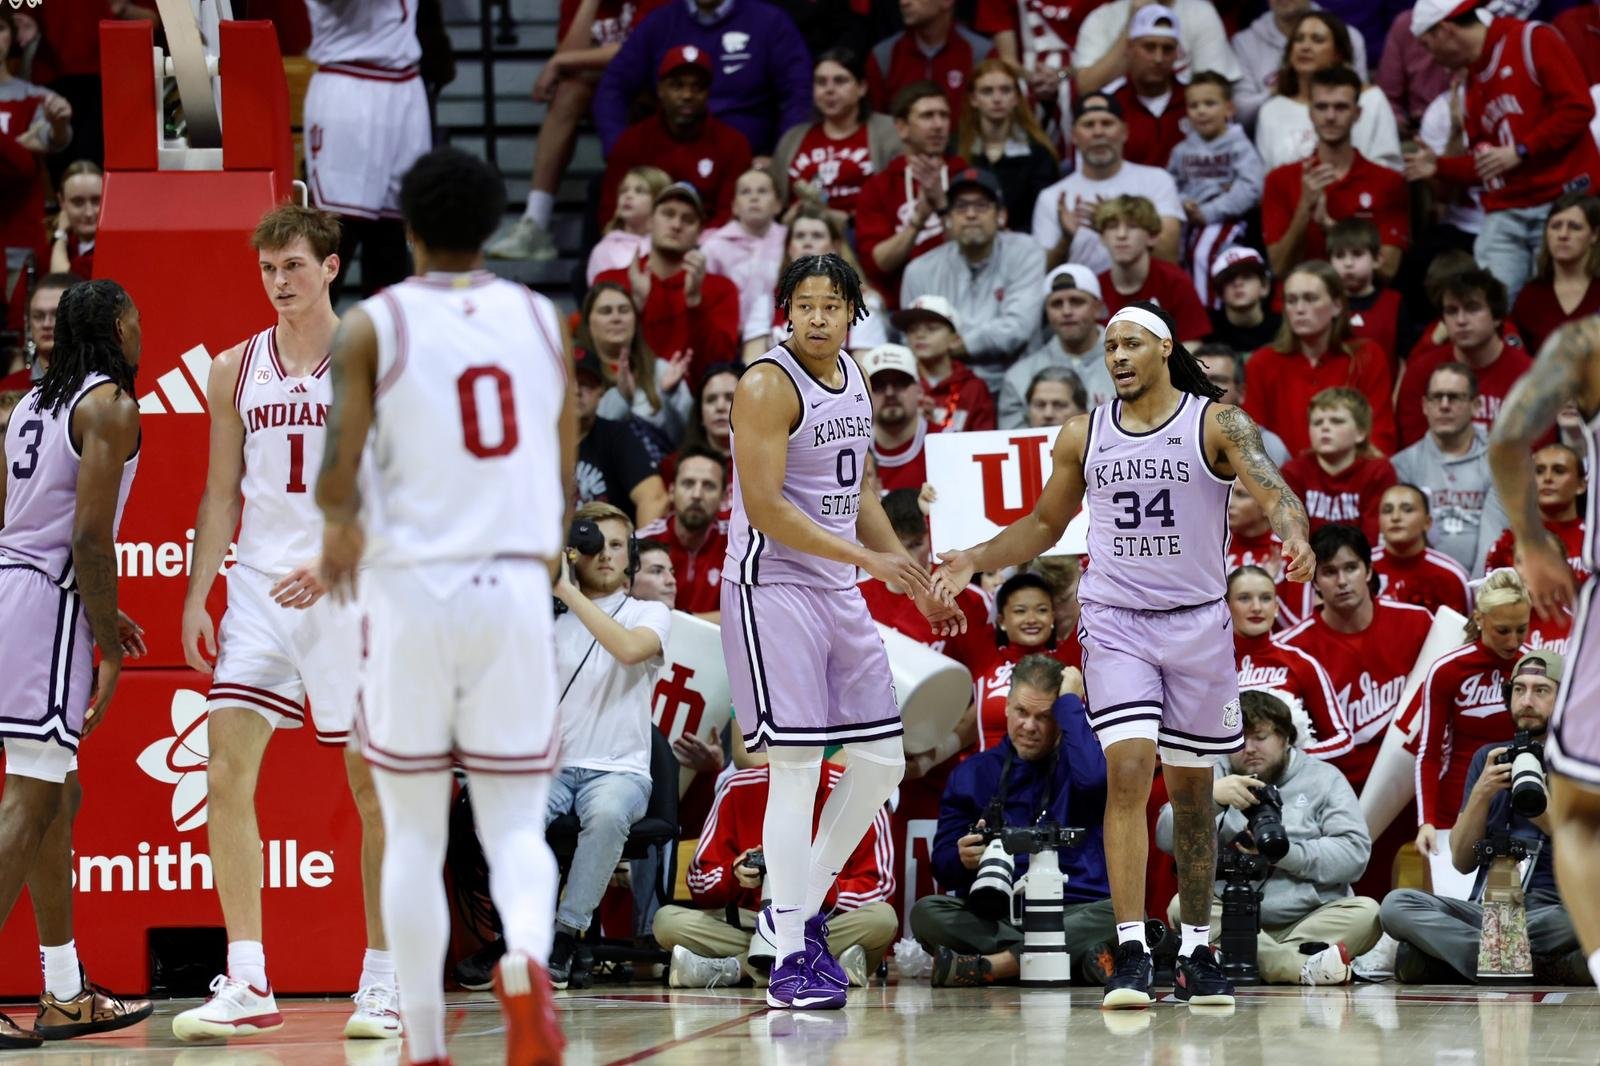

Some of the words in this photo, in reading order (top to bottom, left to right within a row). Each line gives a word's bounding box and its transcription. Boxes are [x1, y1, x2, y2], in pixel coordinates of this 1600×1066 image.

[257, 370, 270, 381] 76
[247, 402, 333, 433] INDIAN
[457, 366, 519, 459] 0
[813, 416, 871, 448] KANSAS
[12, 419, 44, 479] 3
[286, 433, 307, 493] 1
[836, 448, 857, 488] 0
[1095, 458, 1190, 489] KANSAS
[1112, 489, 1175, 530] 34
[1113, 535, 1181, 557] STATE
[72, 839, 335, 892] mithlle
